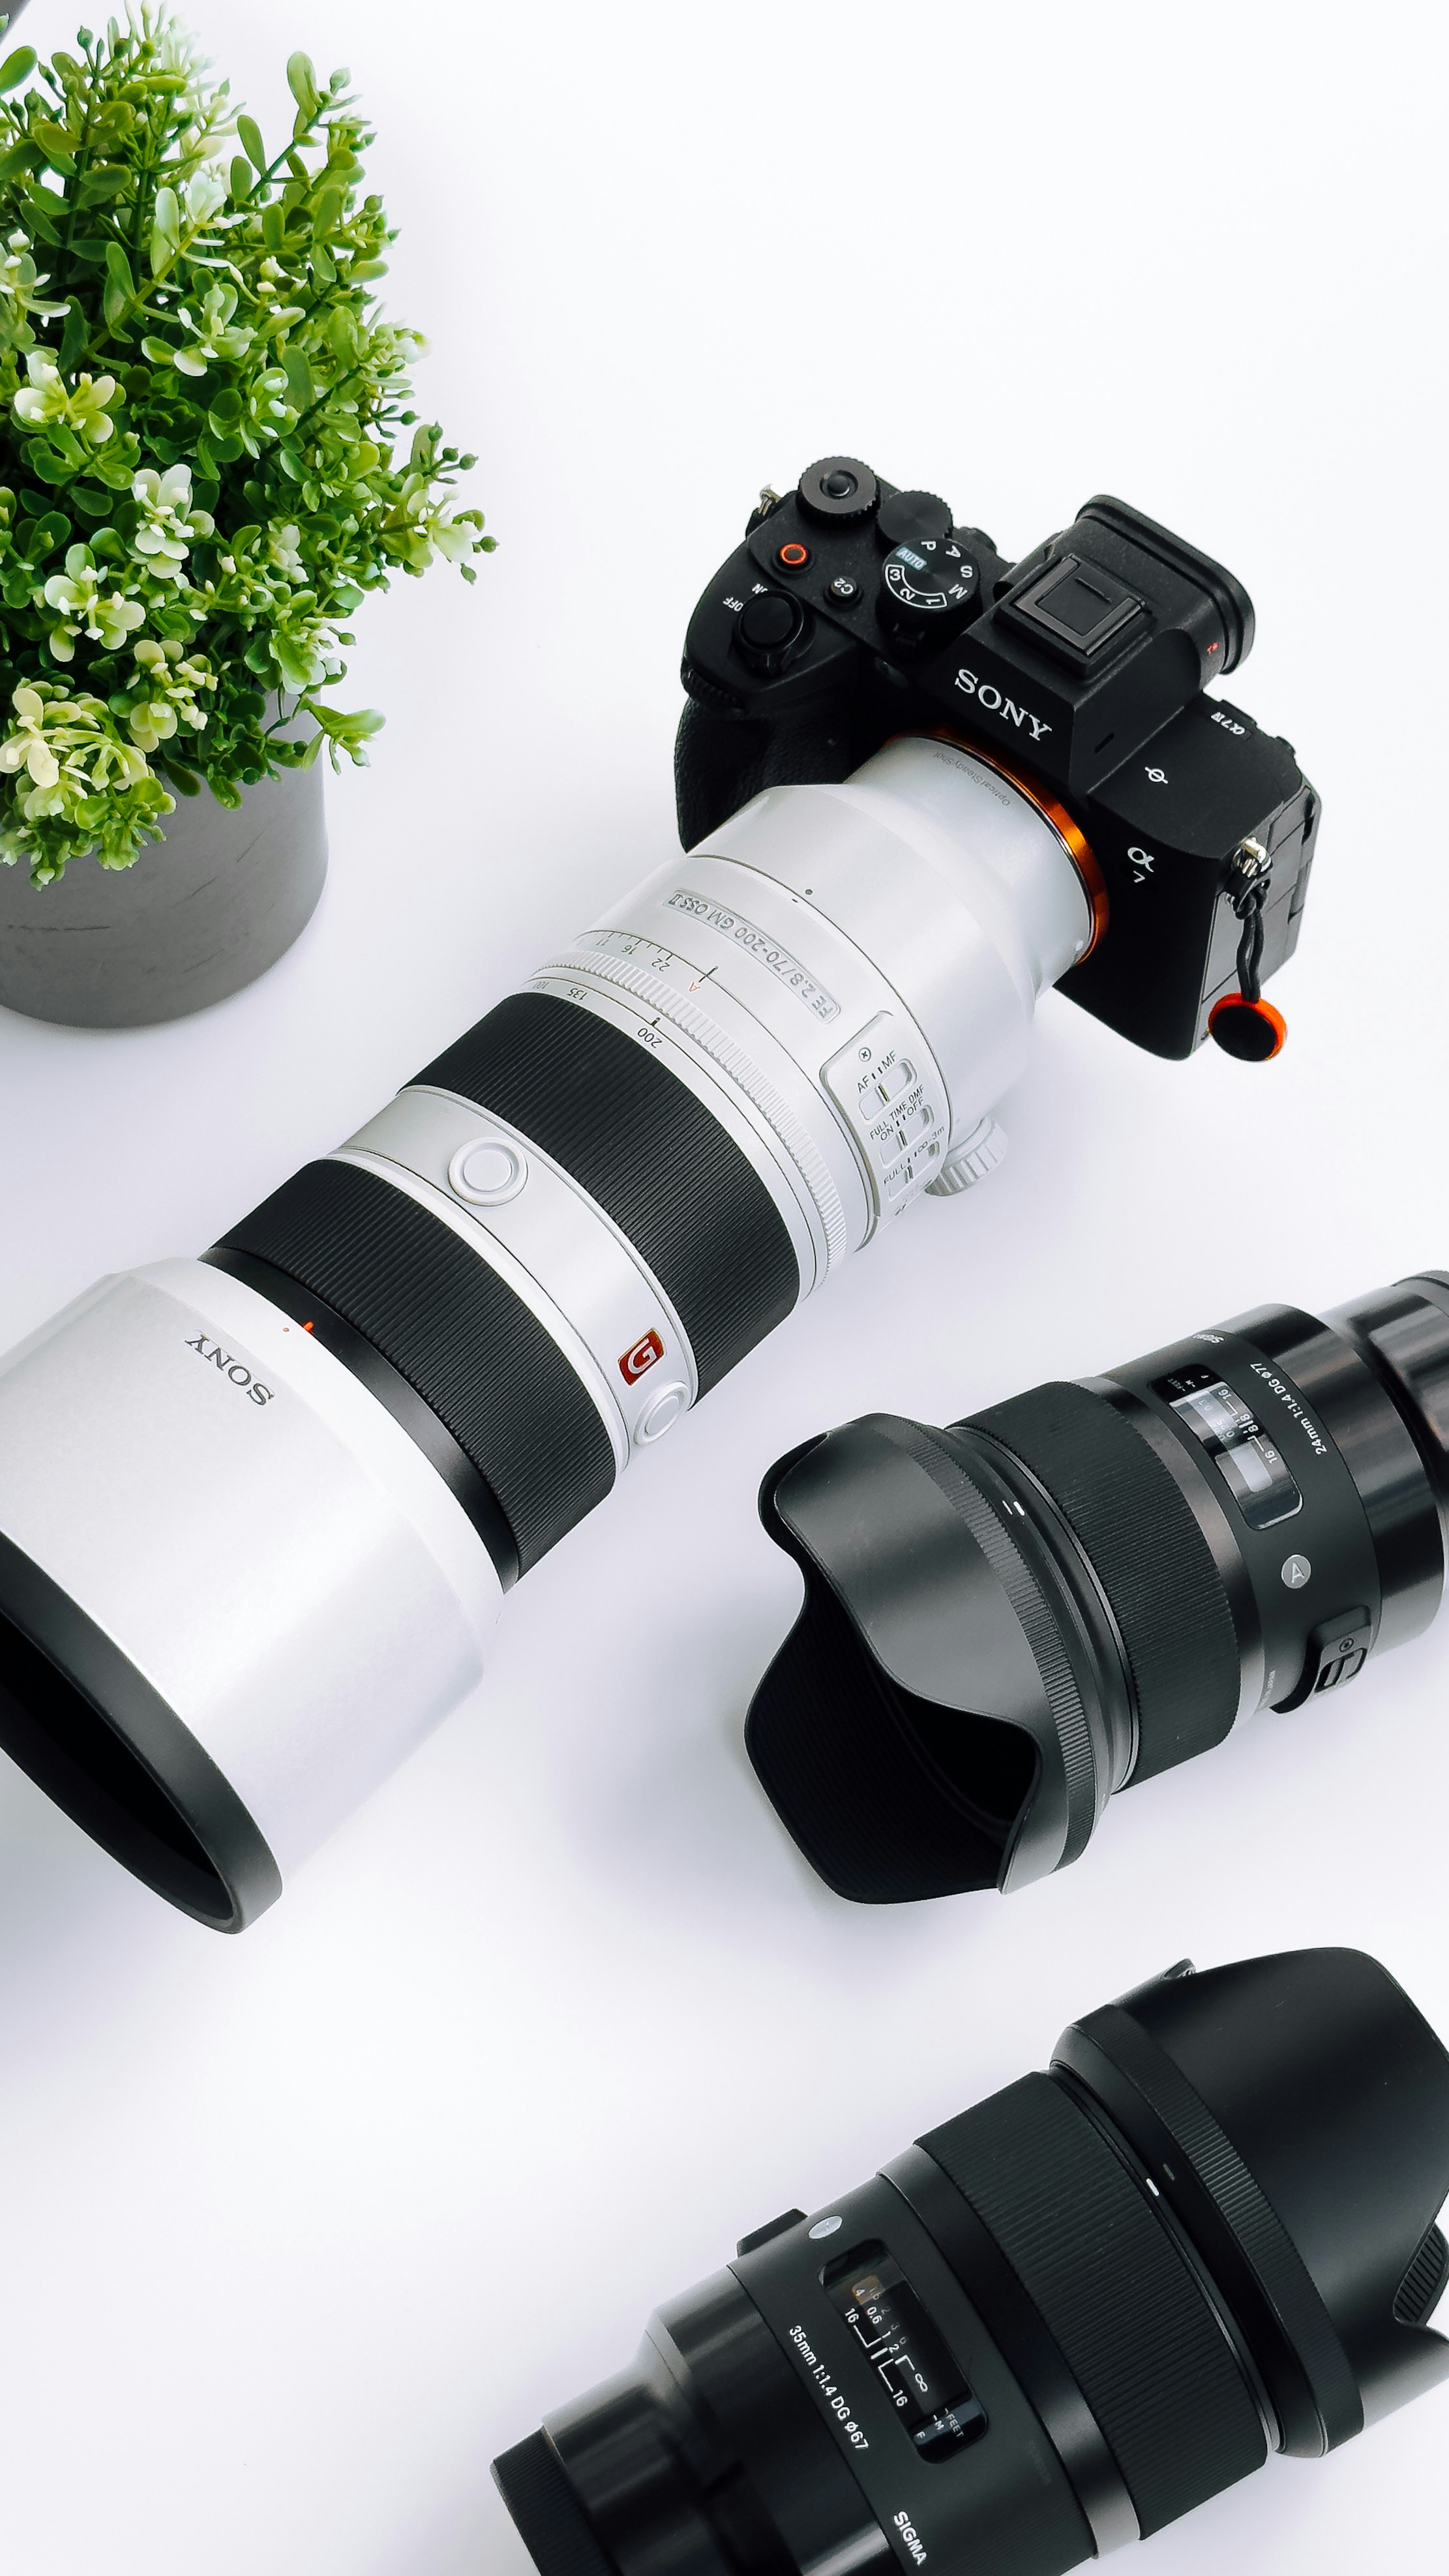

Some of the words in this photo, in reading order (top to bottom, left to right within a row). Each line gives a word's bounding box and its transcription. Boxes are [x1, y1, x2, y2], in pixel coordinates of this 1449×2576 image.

[921, 541, 936, 550] P
[946, 545, 961, 558] A
[897, 548, 925, 569] AUTO
[889, 569, 901, 581] 3
[961, 565, 973, 578] S
[835, 578, 854, 594] C2
[900, 588, 916, 601] 2
[948, 584, 968, 599] M
[723, 597, 743, 612] OFF
[955, 668, 1053, 741] SONY
[680, 897, 709, 915] OSS
[707, 909, 735, 930] GM
[621, 944, 636, 955] 16
[652, 958, 670, 972] 22
[689, 981, 701, 992] A
[735, 927, 816, 998] 2.8/70-200
[567, 987, 588, 1000] 135
[637, 1028, 663, 1049] 200
[811, 995, 833, 1019] FE
[857, 1075, 869, 1094] AF
[881, 1049, 897, 1070] MF
[870, 1121, 889, 1140] FULL
[889, 1101, 907, 1120] TIME
[908, 1085, 925, 1103] DMF
[880, 1124, 894, 1141] ON
[907, 1096, 924, 1116] OFF
[884, 1163, 906, 1186] FULL
[627, 1338, 657, 1374] G
[184, 1334, 275, 1405] SONY
[1268, 1378, 1287, 1394] DG
[1281, 1394, 1304, 1419] 1:1.4
[1218, 1388, 1232, 1400] 16
[1240, 1413, 1251, 1422] 8
[1247, 1424, 1259, 1433] 8
[1265, 1450, 1277, 1464] 16
[1300, 1417, 1328, 1456] 24mm
[1291, 1562, 1305, 1584] A
[867, 2307, 882, 2324] 0.6
[888, 2344, 900, 2354] 2
[845, 2308, 859, 2323] 16
[893, 2389, 908, 2407] 16
[790, 2325, 816, 2366] 35mm
[813, 2364, 837, 2396] 1:1.4
[831, 2395, 850, 2421] DG
[946, 2414, 964, 2437] FEET
[893, 2511, 927, 2566] SIGMA
